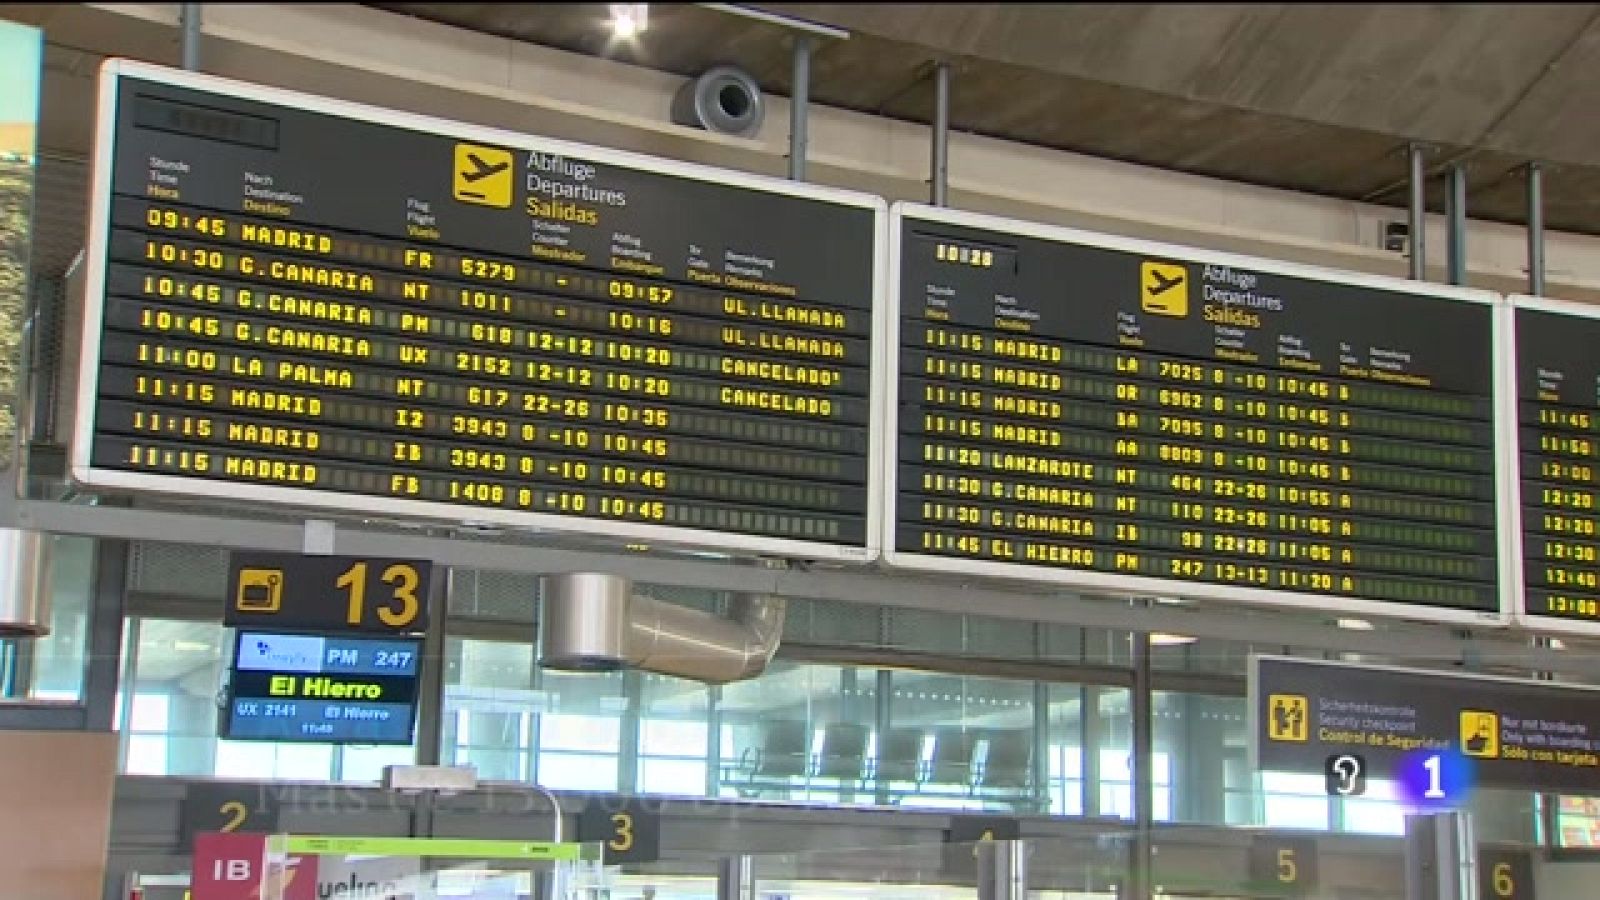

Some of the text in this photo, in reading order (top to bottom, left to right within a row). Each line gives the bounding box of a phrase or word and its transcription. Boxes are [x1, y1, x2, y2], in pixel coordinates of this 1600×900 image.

[149, 169, 179, 185] Time
[526, 173, 626, 206] Departures
[243, 198, 291, 216] Destino
[244, 185, 304, 204] Destination
[526, 196, 598, 226] Salidas
[147, 209, 846, 329] 09:45 MADRID FR 5279 09:57 UL.LLAMADA
[146, 242, 225, 269] 10:30
[402, 282, 430, 301] NT
[461, 290, 511, 313] 1011
[609, 312, 671, 336] 10:16
[722, 329, 844, 357] UL.LLAMADA
[144, 277, 221, 304] 10:45
[401, 314, 429, 333] PM
[527, 331, 594, 356] 12-12
[607, 342, 671, 366] 10:20
[1201, 303, 1261, 330] Salidas
[142, 311, 219, 336] 10:45
[399, 345, 429, 364] UX
[456, 352, 511, 376] 2152
[526, 361, 593, 386] 12-12
[606, 373, 671, 396] 10:20
[719, 387, 831, 416] CANCELADO
[139, 344, 216, 371] 11:00
[232, 357, 264, 376] LA
[279, 361, 353, 389] PALMA
[396, 379, 424, 397] NT
[467, 386, 509, 406] 617
[604, 404, 669, 426] 10:35
[138, 376, 214, 403] 11:15
[231, 389, 321, 416] MADRID
[452, 416, 509, 438] 3943
[604, 434, 666, 456] 10:45
[134, 415, 211, 438] 11:15
[229, 424, 319, 451] MADRID
[451, 449, 506, 471] 3943
[602, 465, 666, 489] 10:45
[132, 448, 209, 471] 11:15
[224, 457, 317, 484] MADRID
[391, 474, 419, 494] FB
[601, 499, 664, 521] 10:45
[336, 561, 420, 627] 13
[325, 648, 359, 666] PM
[374, 650, 412, 668] 247
[269, 674, 383, 700] El Hierro
[1319, 711, 1359, 729] Security
[1319, 727, 1366, 745] Control
[1369, 732, 1385, 747] de
[1502, 729, 1523, 745] Only
[219, 801, 247, 832] 2
[609, 813, 634, 851] 3
[214, 859, 251, 882] IB
[1276, 849, 1297, 882] 5
[1492, 863, 1514, 897] 6
